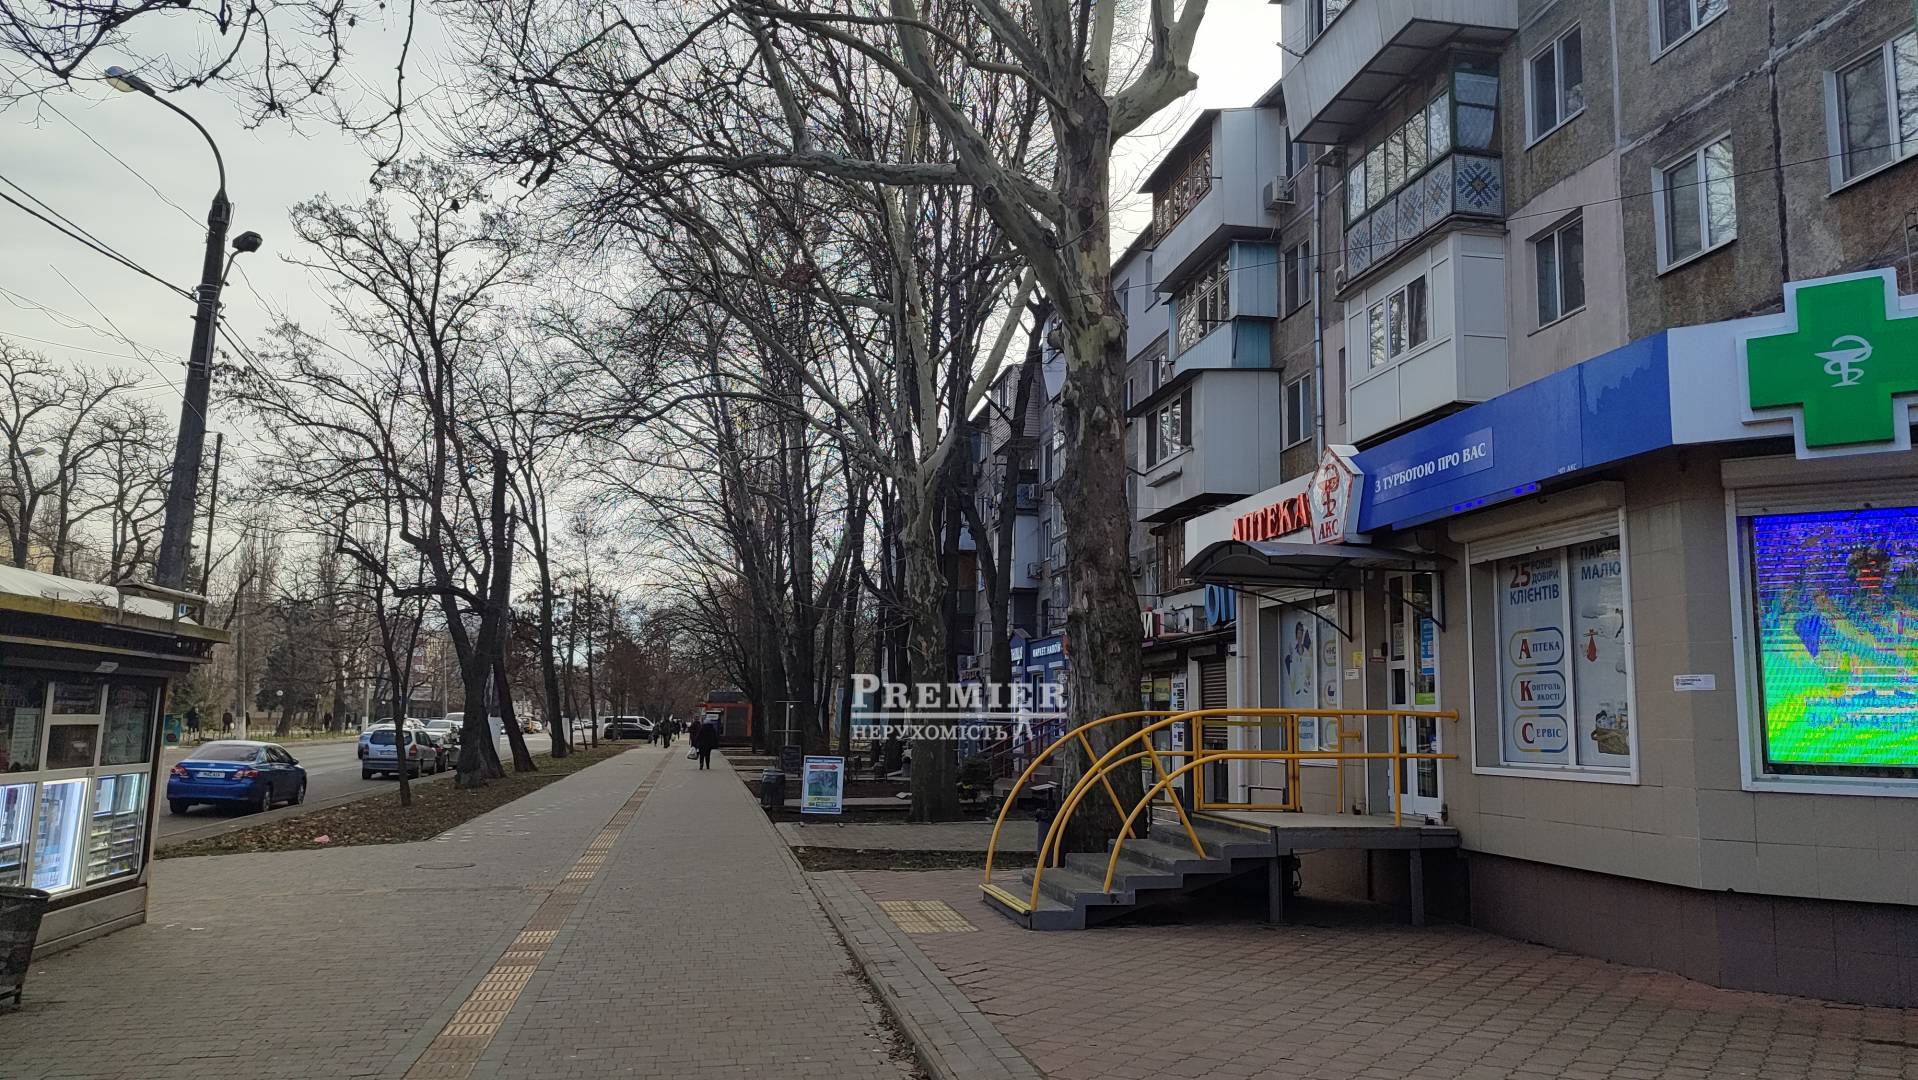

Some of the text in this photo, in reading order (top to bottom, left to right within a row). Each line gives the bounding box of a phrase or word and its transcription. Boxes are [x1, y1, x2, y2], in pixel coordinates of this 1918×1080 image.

[1374, 442, 1487, 493] З ТУРБОТОЮ ПРО ВАС
[1232, 492, 1311, 542] АПТЕКА
[1319, 519, 1339, 540] АКС
[1510, 563, 1531, 588] 25
[1532, 569, 1559, 585] ДОВІРИ
[1510, 584, 1560, 605] КЛІЄНТІВ
[1519, 639, 1560, 659] АПТЕКА
[1520, 681, 1561, 701] КОНТРОЛЬ
[1522, 722, 1561, 744] СЕРВІС
